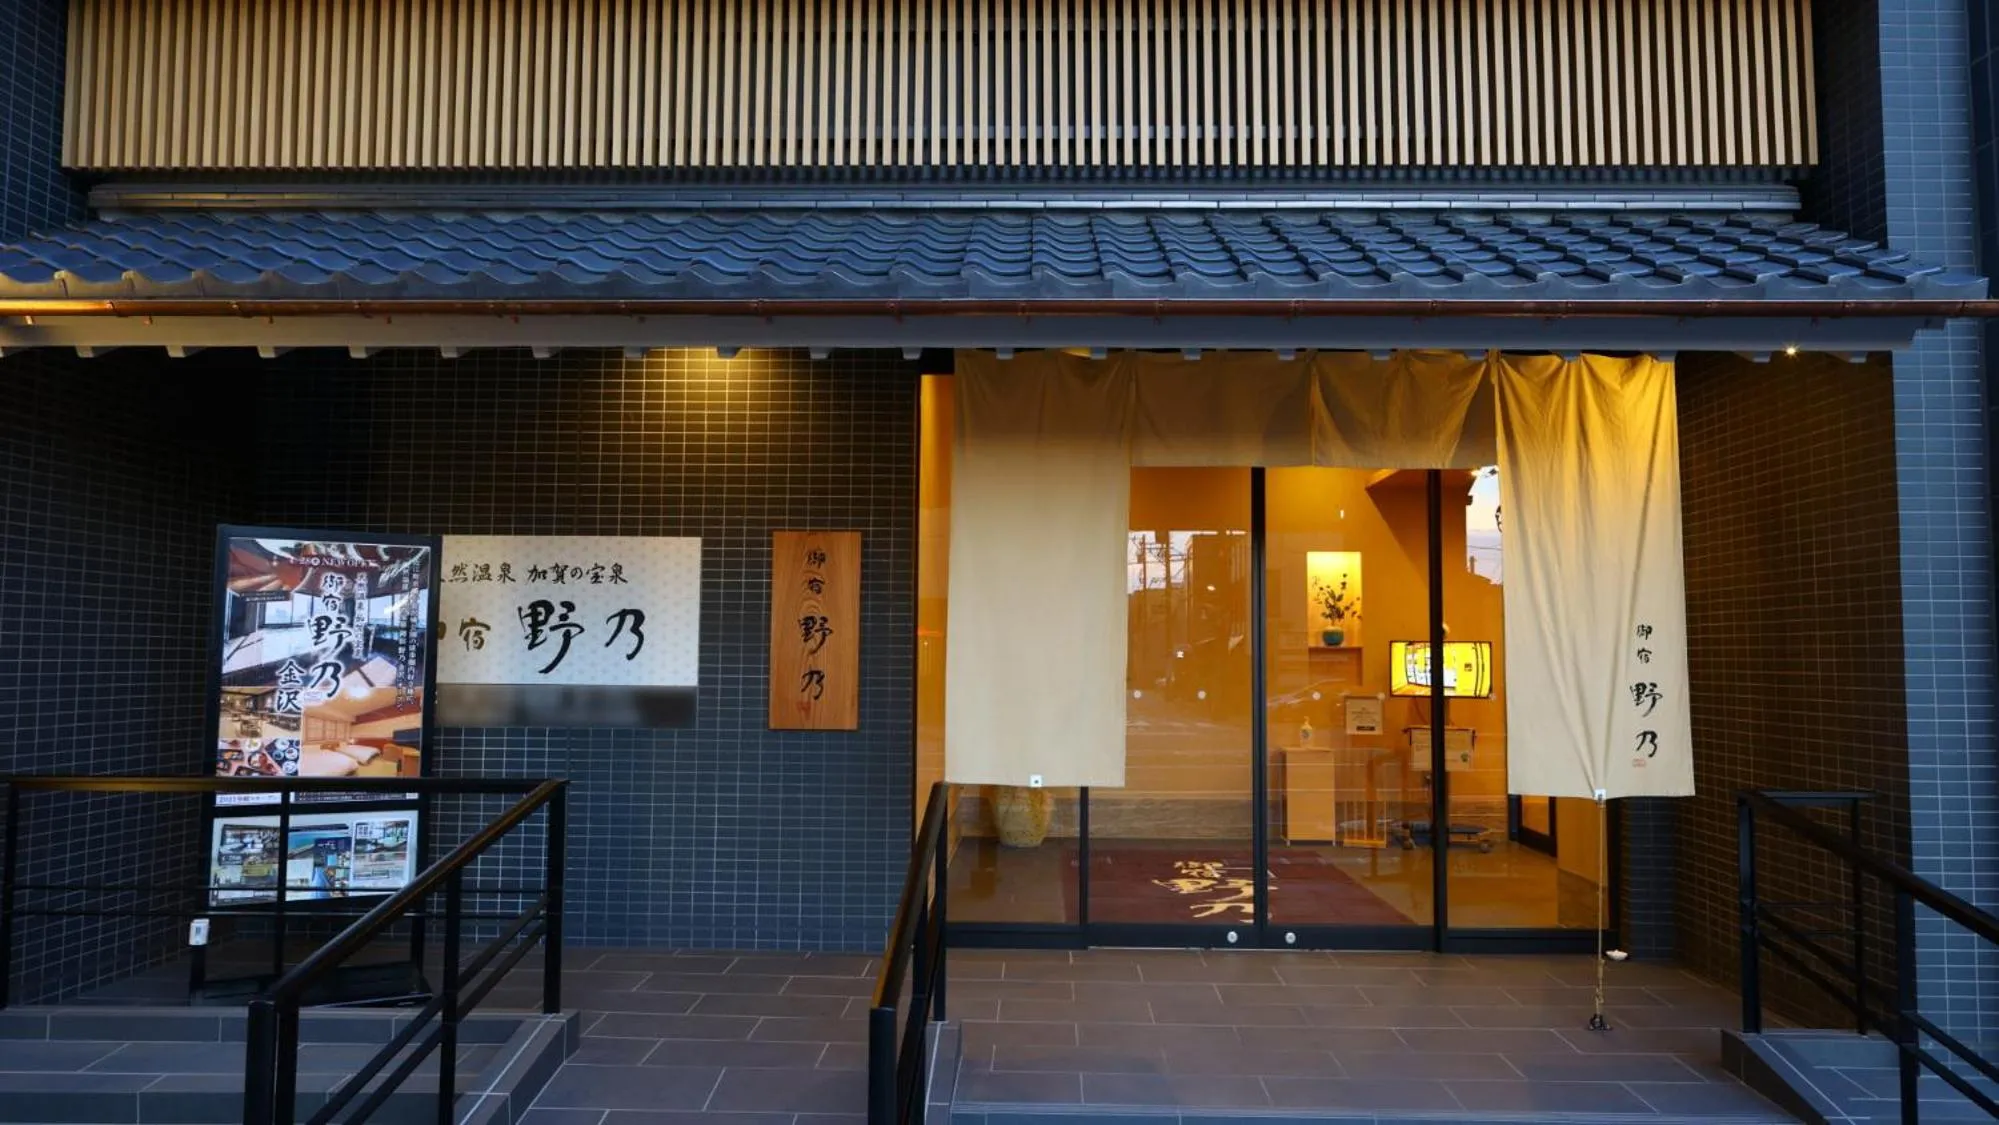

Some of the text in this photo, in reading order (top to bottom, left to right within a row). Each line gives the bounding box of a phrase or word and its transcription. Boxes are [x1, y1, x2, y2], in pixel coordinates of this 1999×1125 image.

[440, 562, 629, 585] 然温泉 加賀の宝泉
[437, 599, 646, 675] 宿野乃
[277, 660, 305, 711] 金沢
